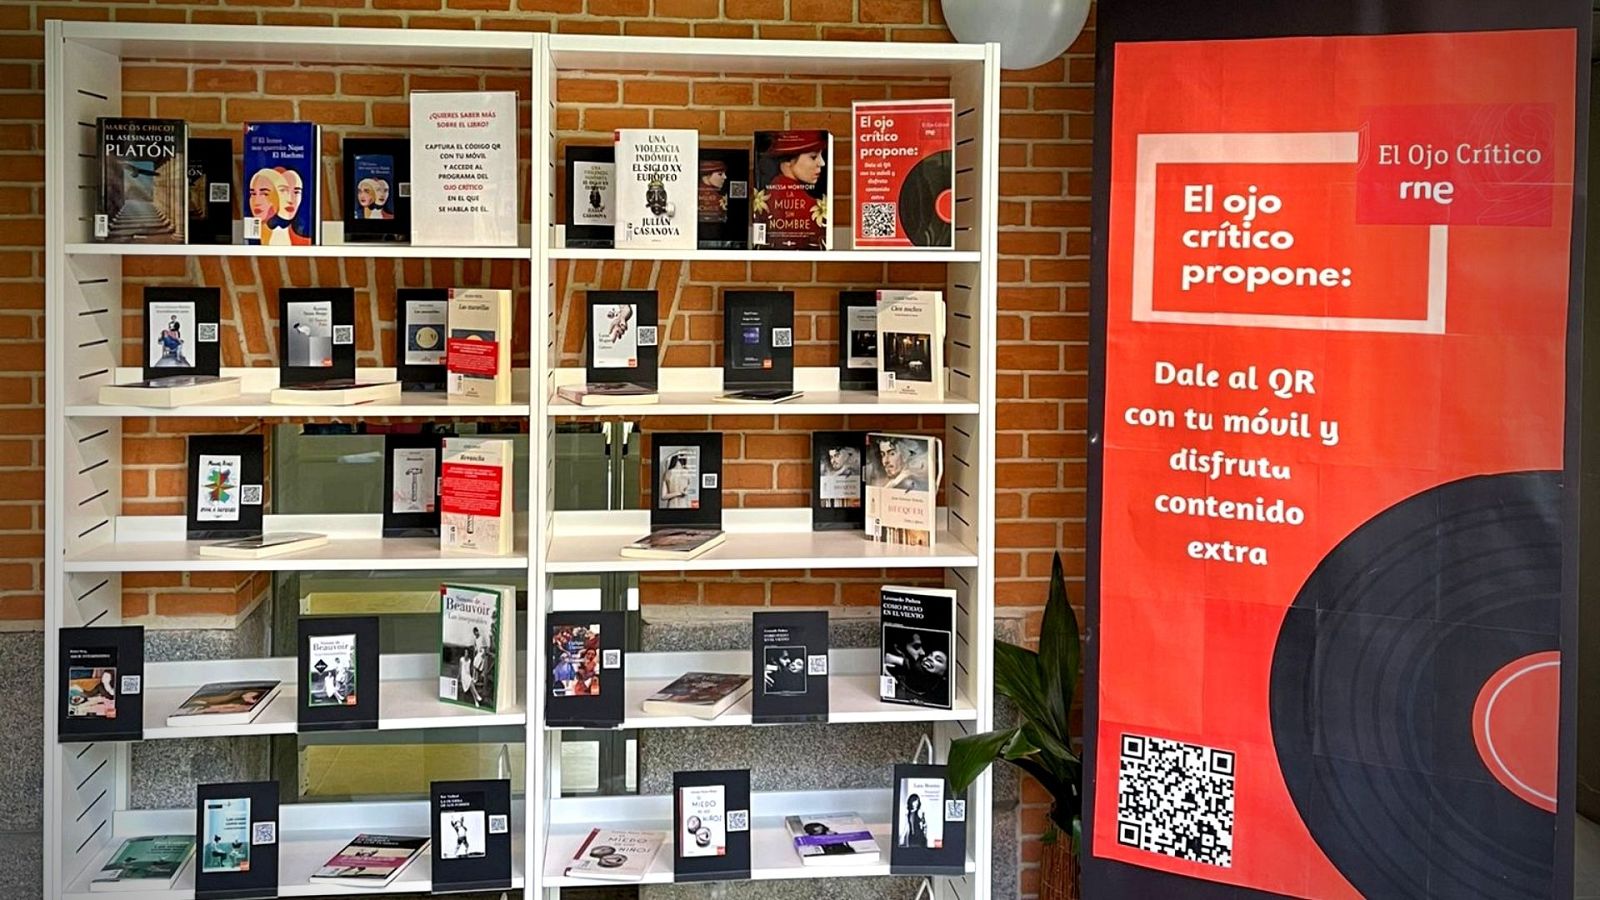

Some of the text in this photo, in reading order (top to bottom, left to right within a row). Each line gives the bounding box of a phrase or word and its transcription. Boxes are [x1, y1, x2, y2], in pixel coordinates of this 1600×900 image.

[429, 112, 460, 120] ¿QUIERES
[106, 124, 140, 132] MARCOS
[860, 116, 894, 133] El ojo
[116, 134, 162, 142] ASESINATO
[648, 135, 666, 144] UNA
[860, 130, 898, 142] crítico
[106, 142, 175, 158] PLATÓN
[464, 142, 490, 150] CÓDIGO
[634, 144, 680, 153] VIOLENCIA
[636, 153, 679, 162] INDÓMITA
[860, 146, 918, 160] propone:
[1379, 143, 1542, 170] El Ojo Crítico
[632, 164, 682, 173] EL SIGLO XX
[636, 173, 678, 182] EUROPEO
[1400, 180, 1454, 205] rne
[774, 199, 806, 210] MUJER
[1184, 185, 1282, 220] El ojo
[642, 216, 671, 227] JULIÁN
[770, 218, 811, 230] NOMBRE
[634, 227, 680, 236] CASANOVA
[1182, 221, 1294, 250] crítico
[1182, 262, 1352, 292] propone:
[1154, 362, 1316, 398] Dale al QR
[1124, 407, 1340, 446] con tu móvil y
[1154, 494, 1304, 525] contenido
[1187, 540, 1268, 566] extra
[446, 597, 490, 616] Beauvoir
